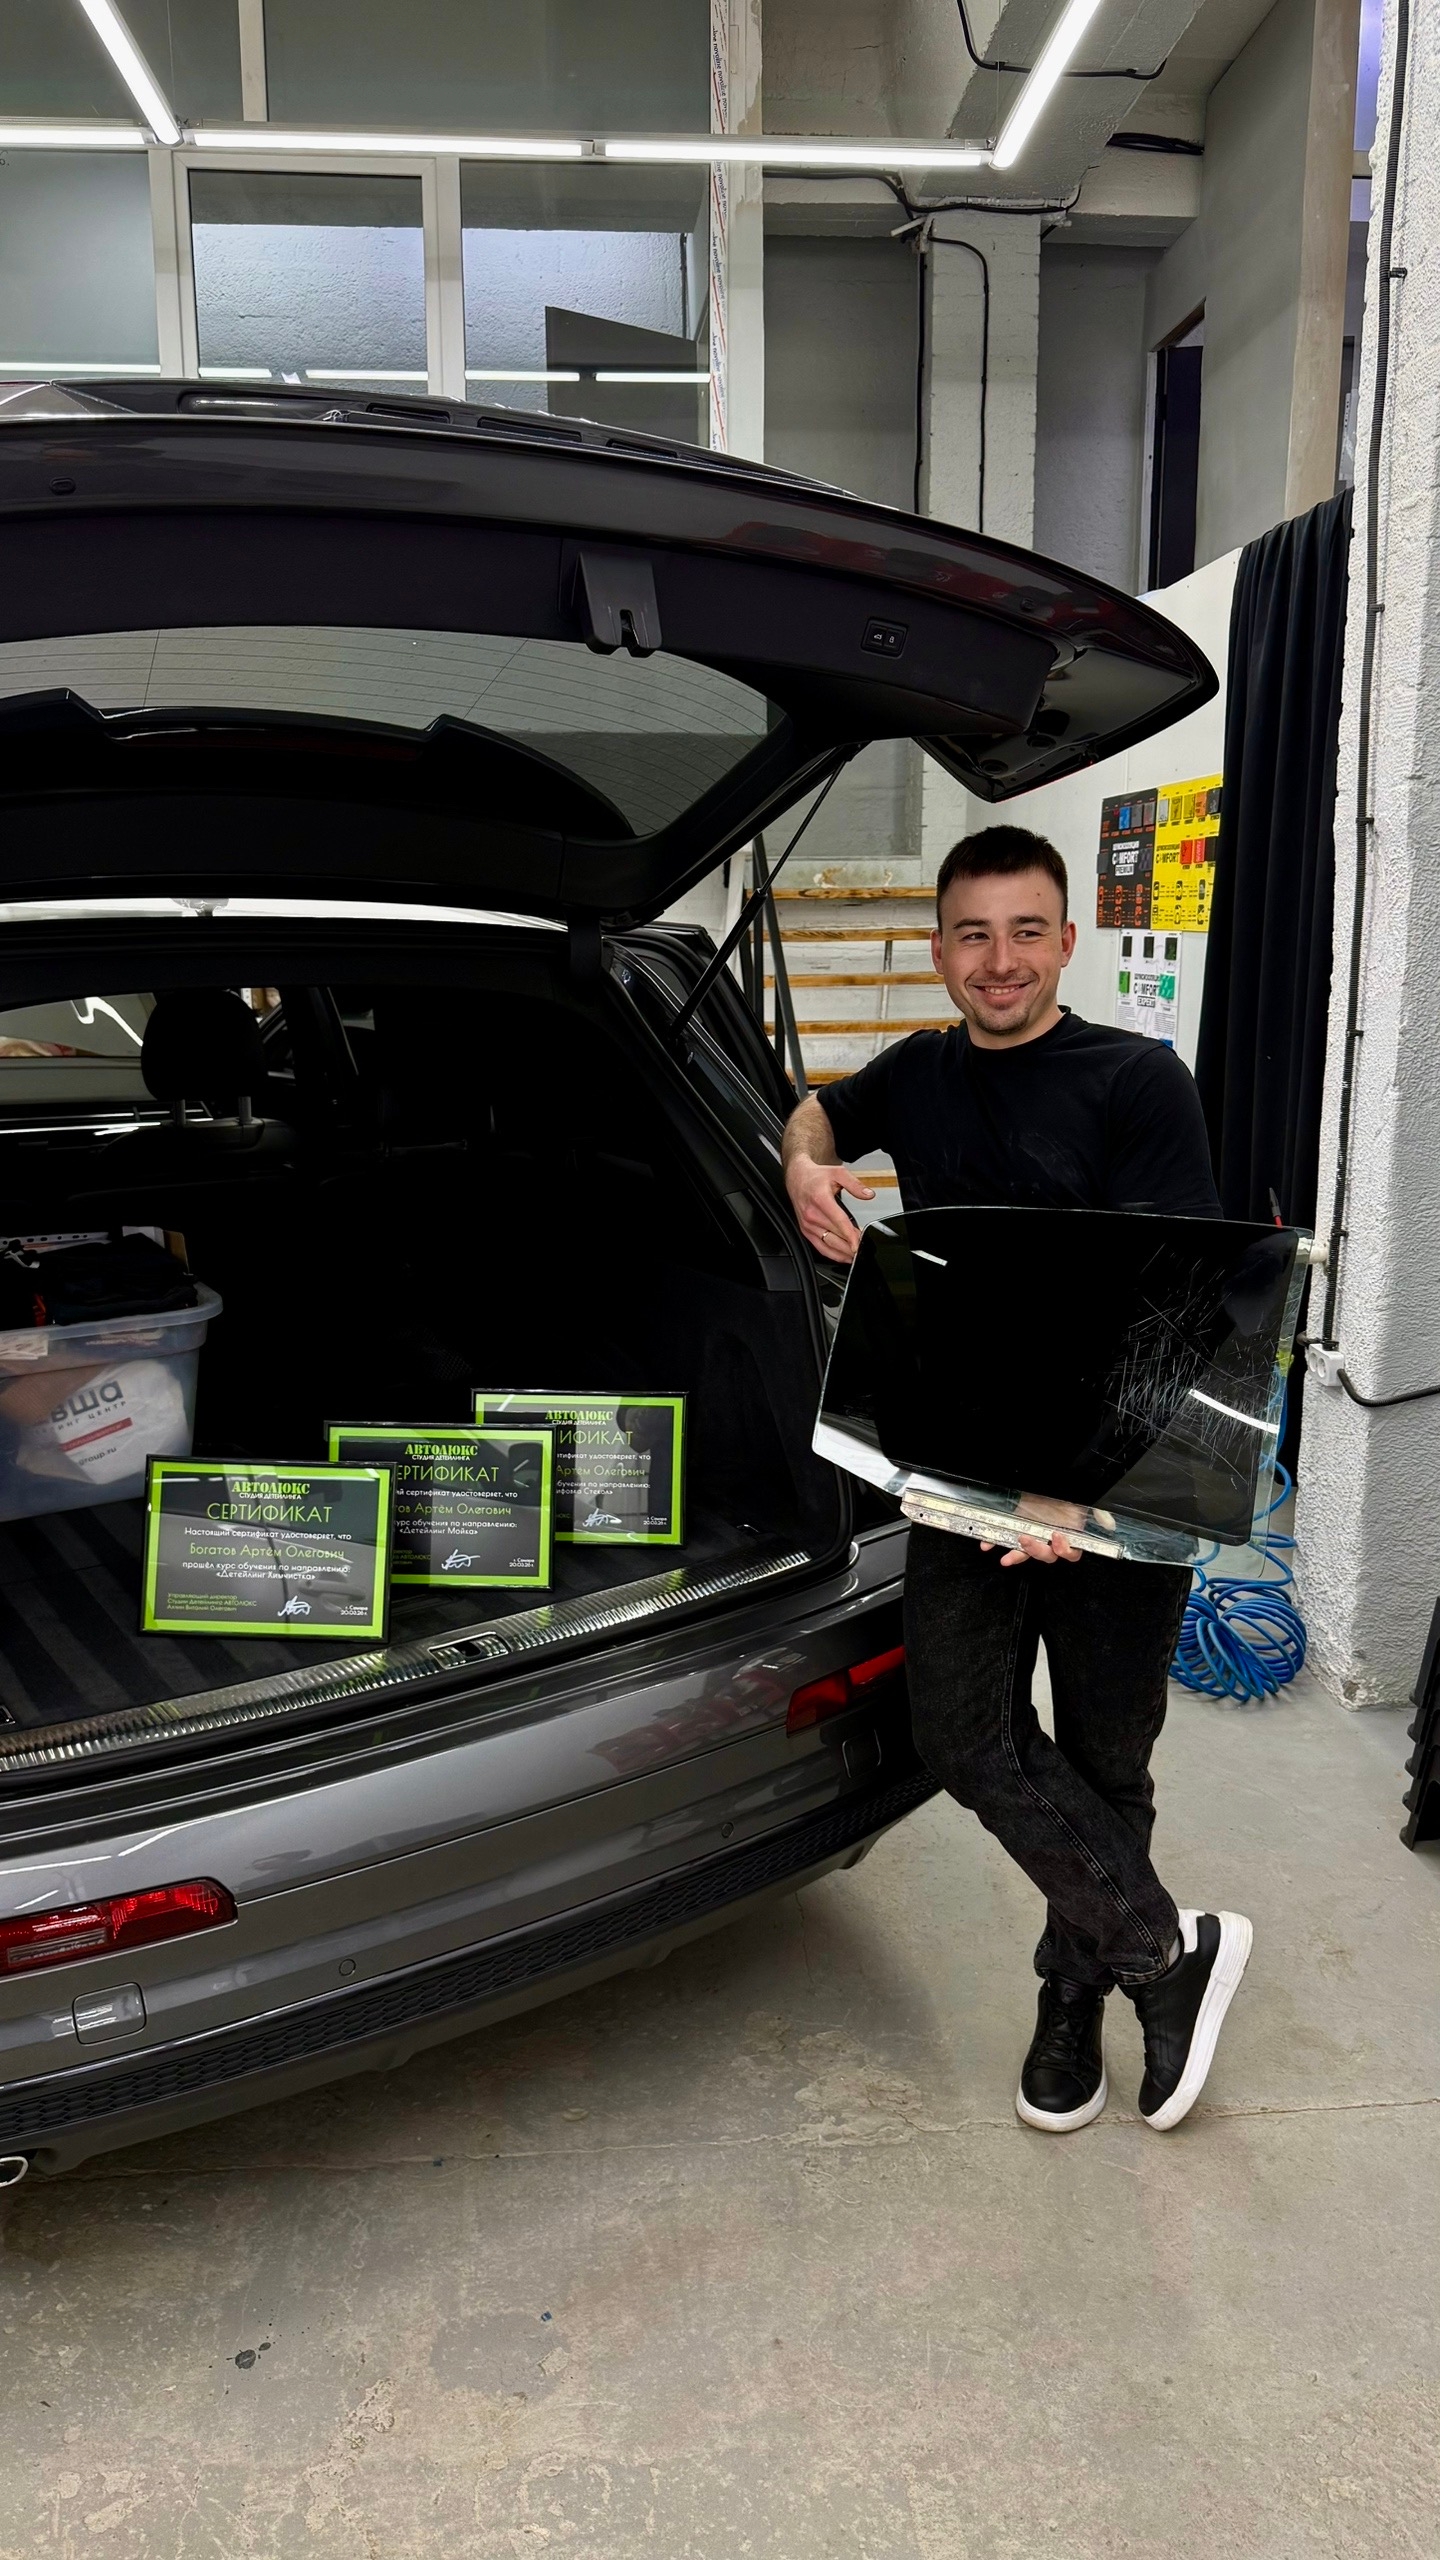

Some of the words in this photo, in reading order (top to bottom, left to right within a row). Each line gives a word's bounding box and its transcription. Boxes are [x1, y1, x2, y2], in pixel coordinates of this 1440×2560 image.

[713, 43, 722, 69] novoline
[717, 70, 726, 96] novoline
[713, 248, 722, 273] novoline
[88, 1401, 127, 1419] ЦЕНТР
[545, 1410, 613, 1421] АВТОЛЮКС
[559, 1430, 634, 1445] ИФИКАТ
[405, 1443, 478, 1456] АВТОЛЮКС
[397, 1465, 499, 1482] ЕРТИФИКАТ
[594, 1465, 646, 1476] Олегович
[231, 1481, 310, 1495] АВТОЛЮКС
[406, 1489, 449, 1497] сертификат
[451, 1490, 503, 1498] удостоверяет,
[207, 1502, 333, 1523] СЕРТИФИКАТ
[414, 1502, 453, 1515] Артём
[456, 1503, 512, 1515] Олегович
[412, 1519, 448, 1527] обучения
[184, 1527, 230, 1537] Настоящий
[231, 1530, 279, 1539] сертификат
[399, 1526, 445, 1534] «Детейлинг
[447, 1527, 478, 1535] Мойка»
[190, 1543, 236, 1556] Богатов
[240, 1544, 282, 1558] Артём
[285, 1545, 345, 1559] Олегович
[182, 1561, 215, 1570] прошёл
[216, 1562, 236, 1571] курс
[238, 1561, 277, 1570] обучения
[291, 1564, 351, 1573] направлению:
[216, 1569, 266, 1578] «Детейлинг
